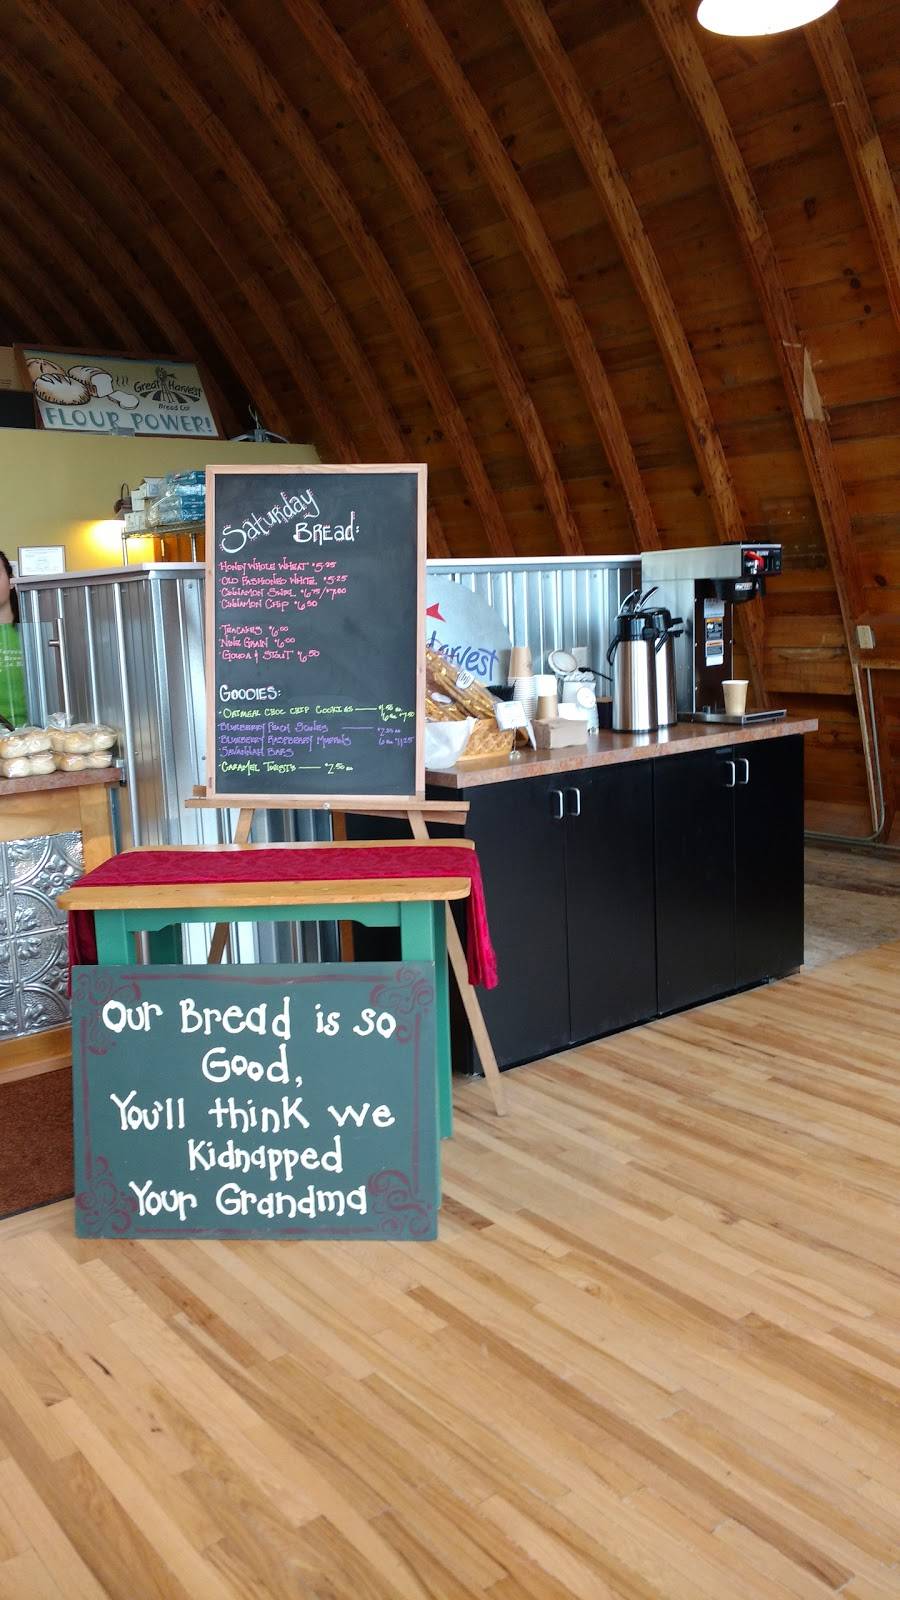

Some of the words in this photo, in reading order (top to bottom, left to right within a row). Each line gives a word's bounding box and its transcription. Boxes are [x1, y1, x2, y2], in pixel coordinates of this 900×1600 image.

[134, 380, 160, 393] Great
[168, 380, 201, 397] Harvest
[45, 407, 119, 429] FLOUR
[131, 412, 213, 433] POWER!
[248, 558, 276, 571] WHOLE
[219, 684, 281, 702] GOODIES:
[102, 1000, 164, 1034] Our
[179, 996, 291, 1040] Bread
[316, 1004, 340, 1037] is
[353, 1007, 397, 1039] so
[202, 1043, 303, 1087] Good,
[111, 1090, 184, 1131] You'll
[208, 1096, 310, 1133] think
[328, 1103, 396, 1129] we
[188, 1135, 343, 1181] Kidnapped
[129, 1180, 197, 1221] Your
[216, 1182, 367, 1219] Grandma
